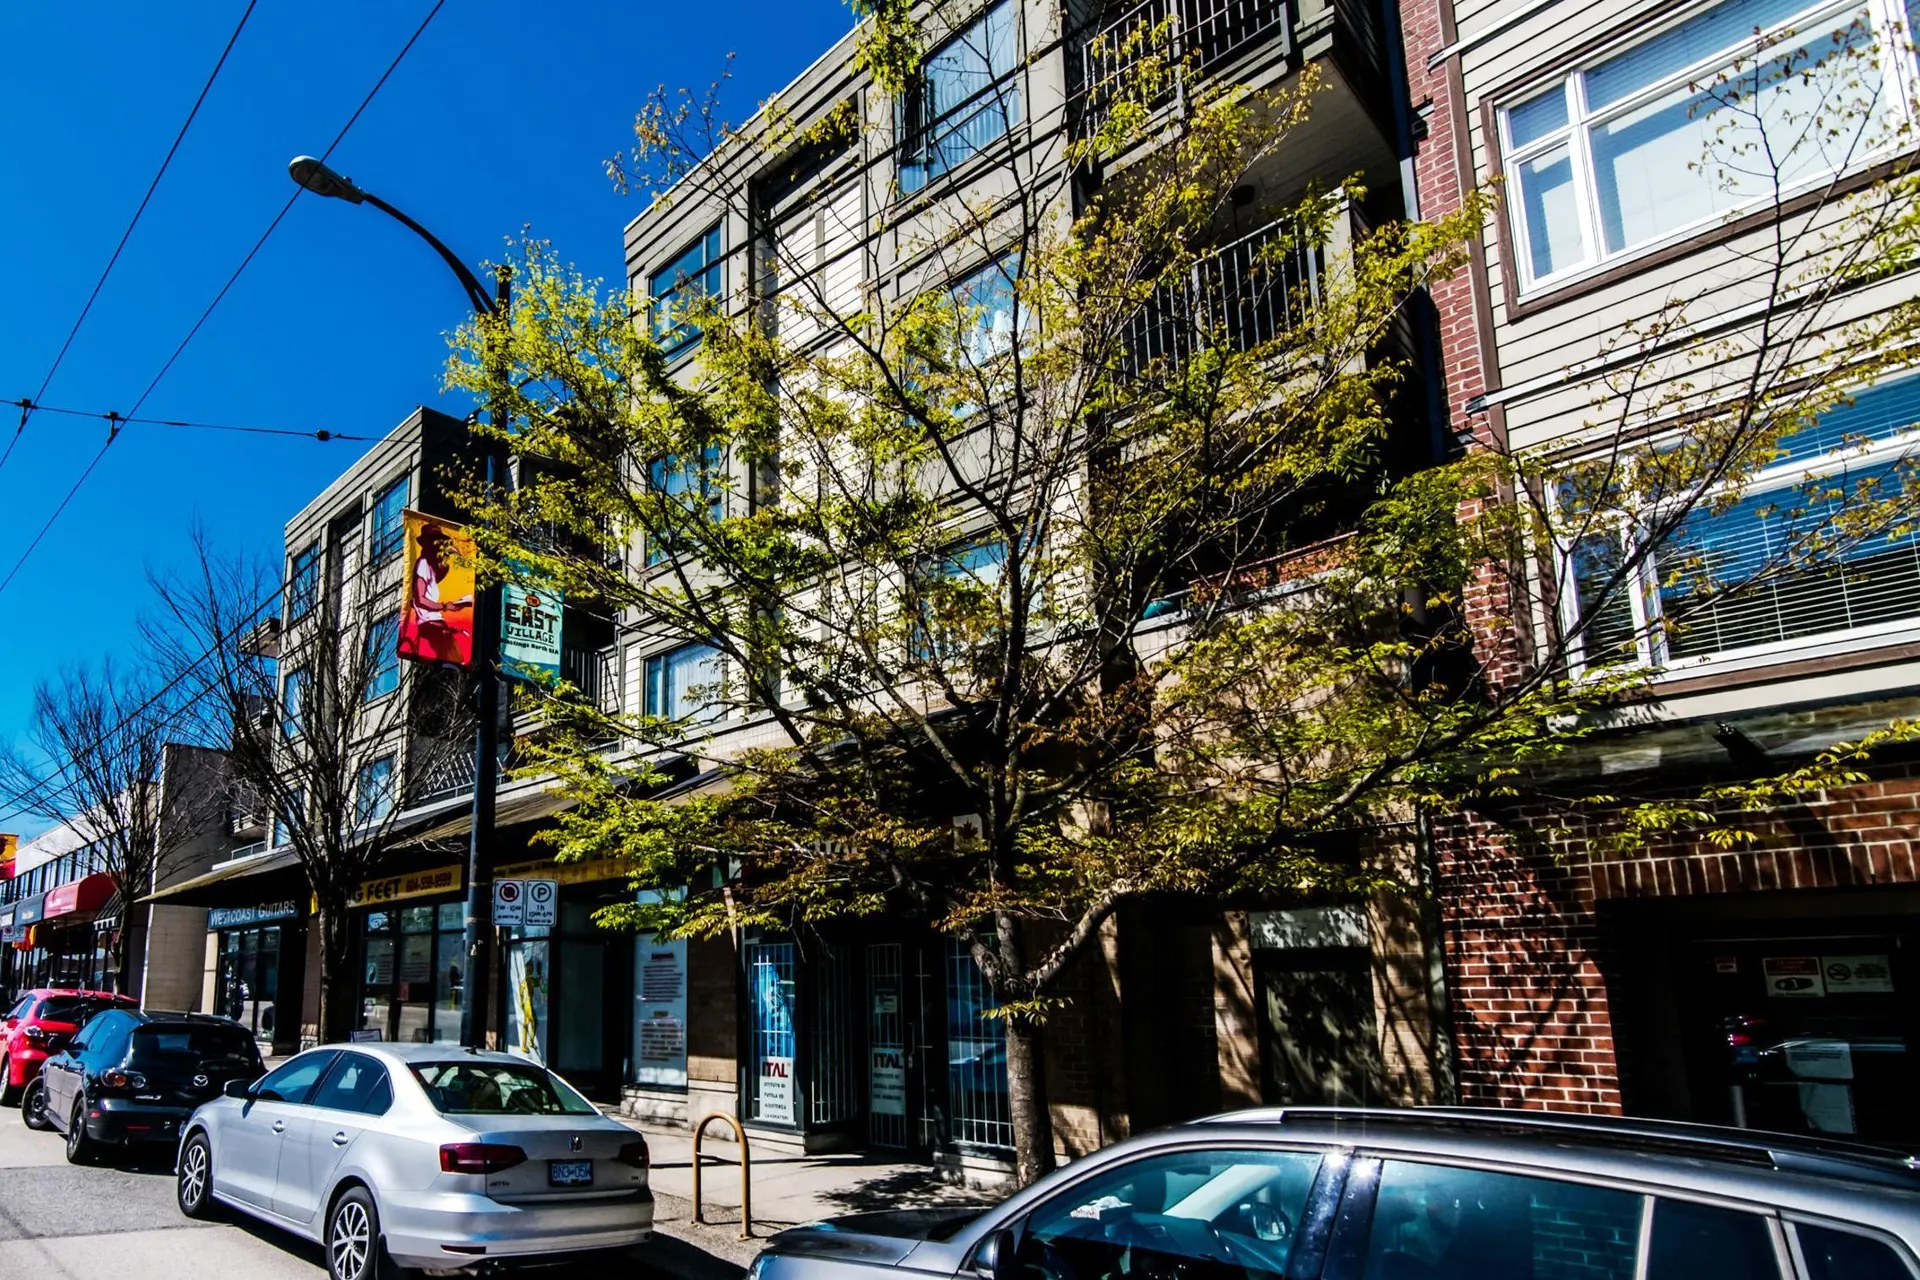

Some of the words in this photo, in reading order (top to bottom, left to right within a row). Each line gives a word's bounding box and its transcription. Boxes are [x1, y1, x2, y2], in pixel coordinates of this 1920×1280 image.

[505, 602, 559, 633] EAST
[504, 625, 554, 644] VILLAGE
[504, 639, 530, 648] astings
[366, 878, 402, 901] FEET
[762, 1061, 788, 1078] ITAL
[874, 1053, 903, 1070] ITAL
